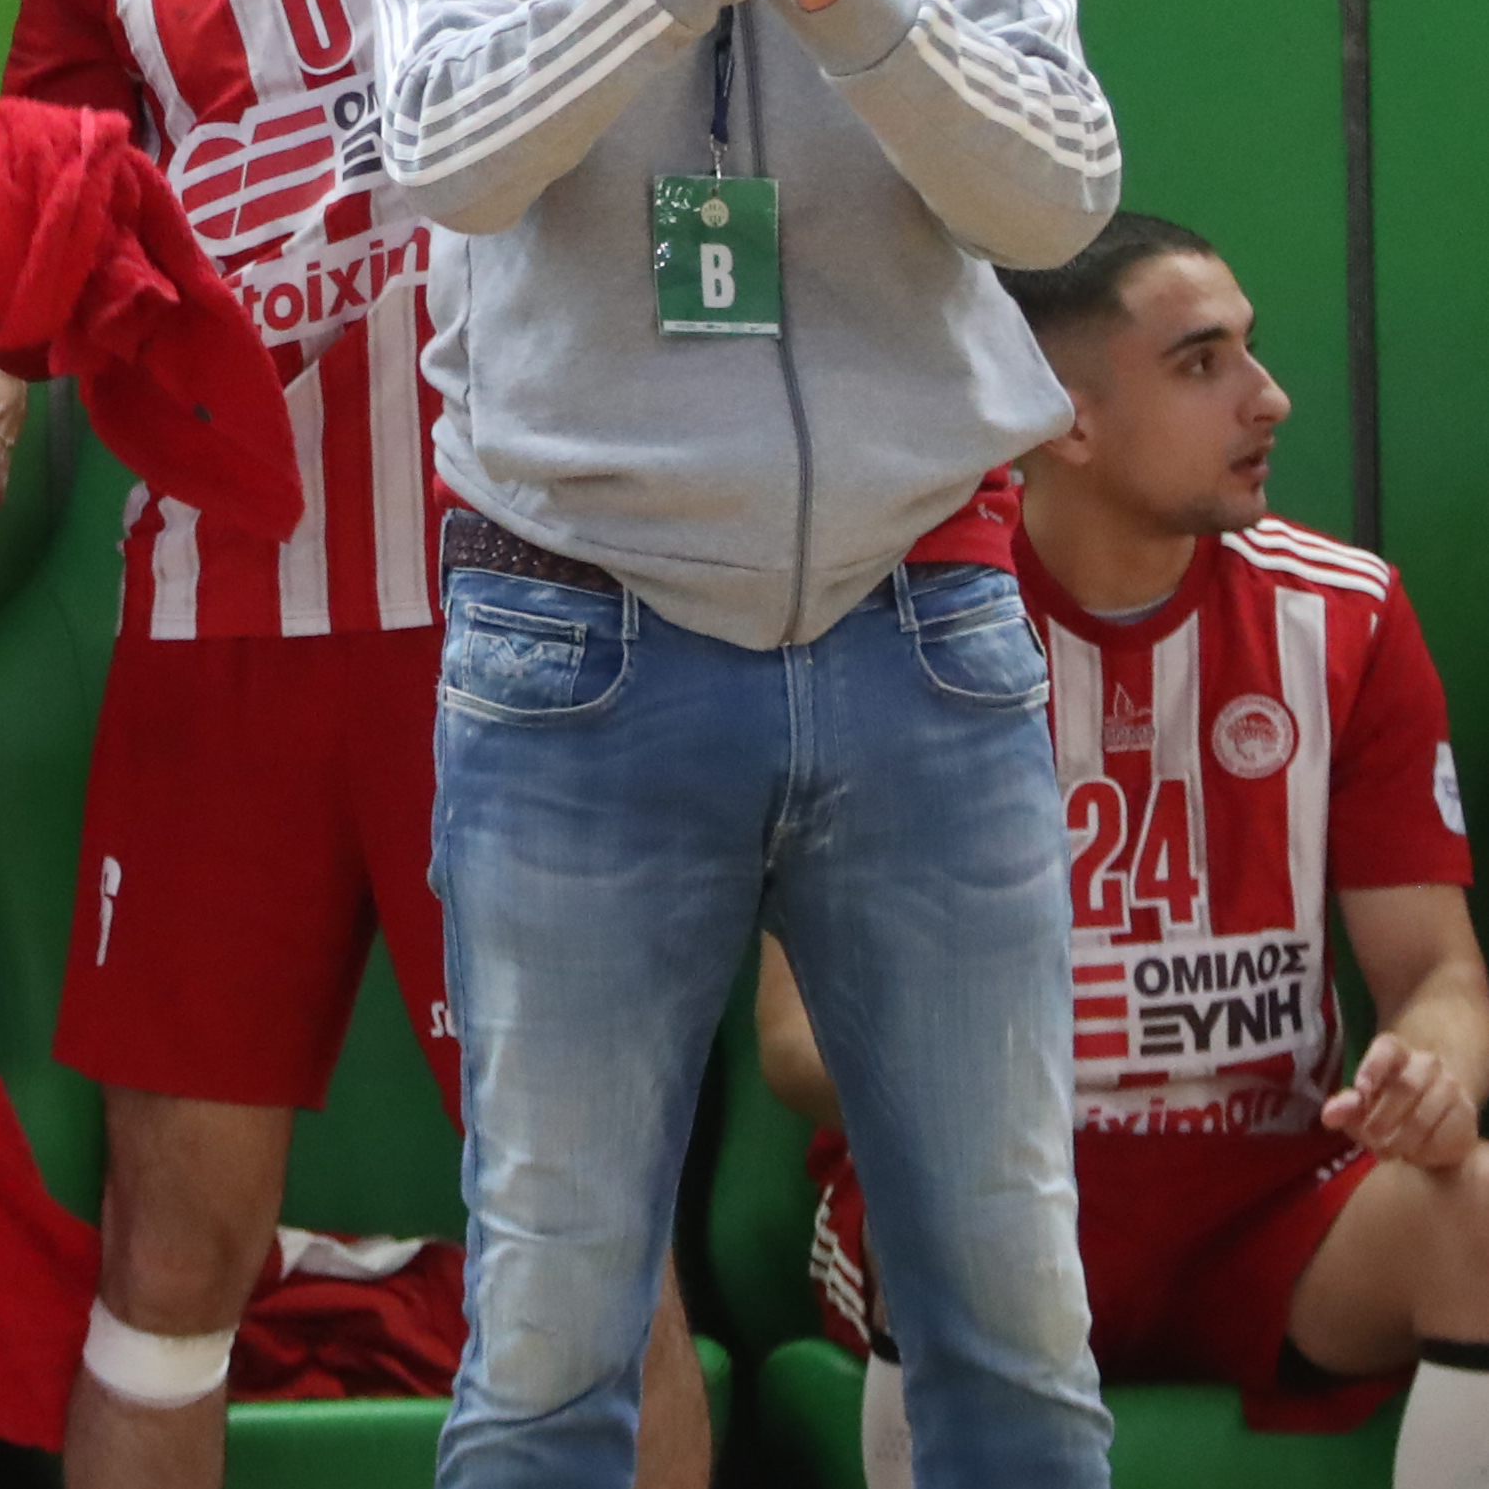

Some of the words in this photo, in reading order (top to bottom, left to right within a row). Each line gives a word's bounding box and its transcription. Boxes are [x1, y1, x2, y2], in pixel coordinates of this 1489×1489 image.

[700, 242, 736, 308] B
[1064, 776, 1202, 933] 24
[1133, 942, 1309, 998] ΟΜΙΛΟΣ
[1139, 981, 1304, 1057] ΞΥΝΗ
